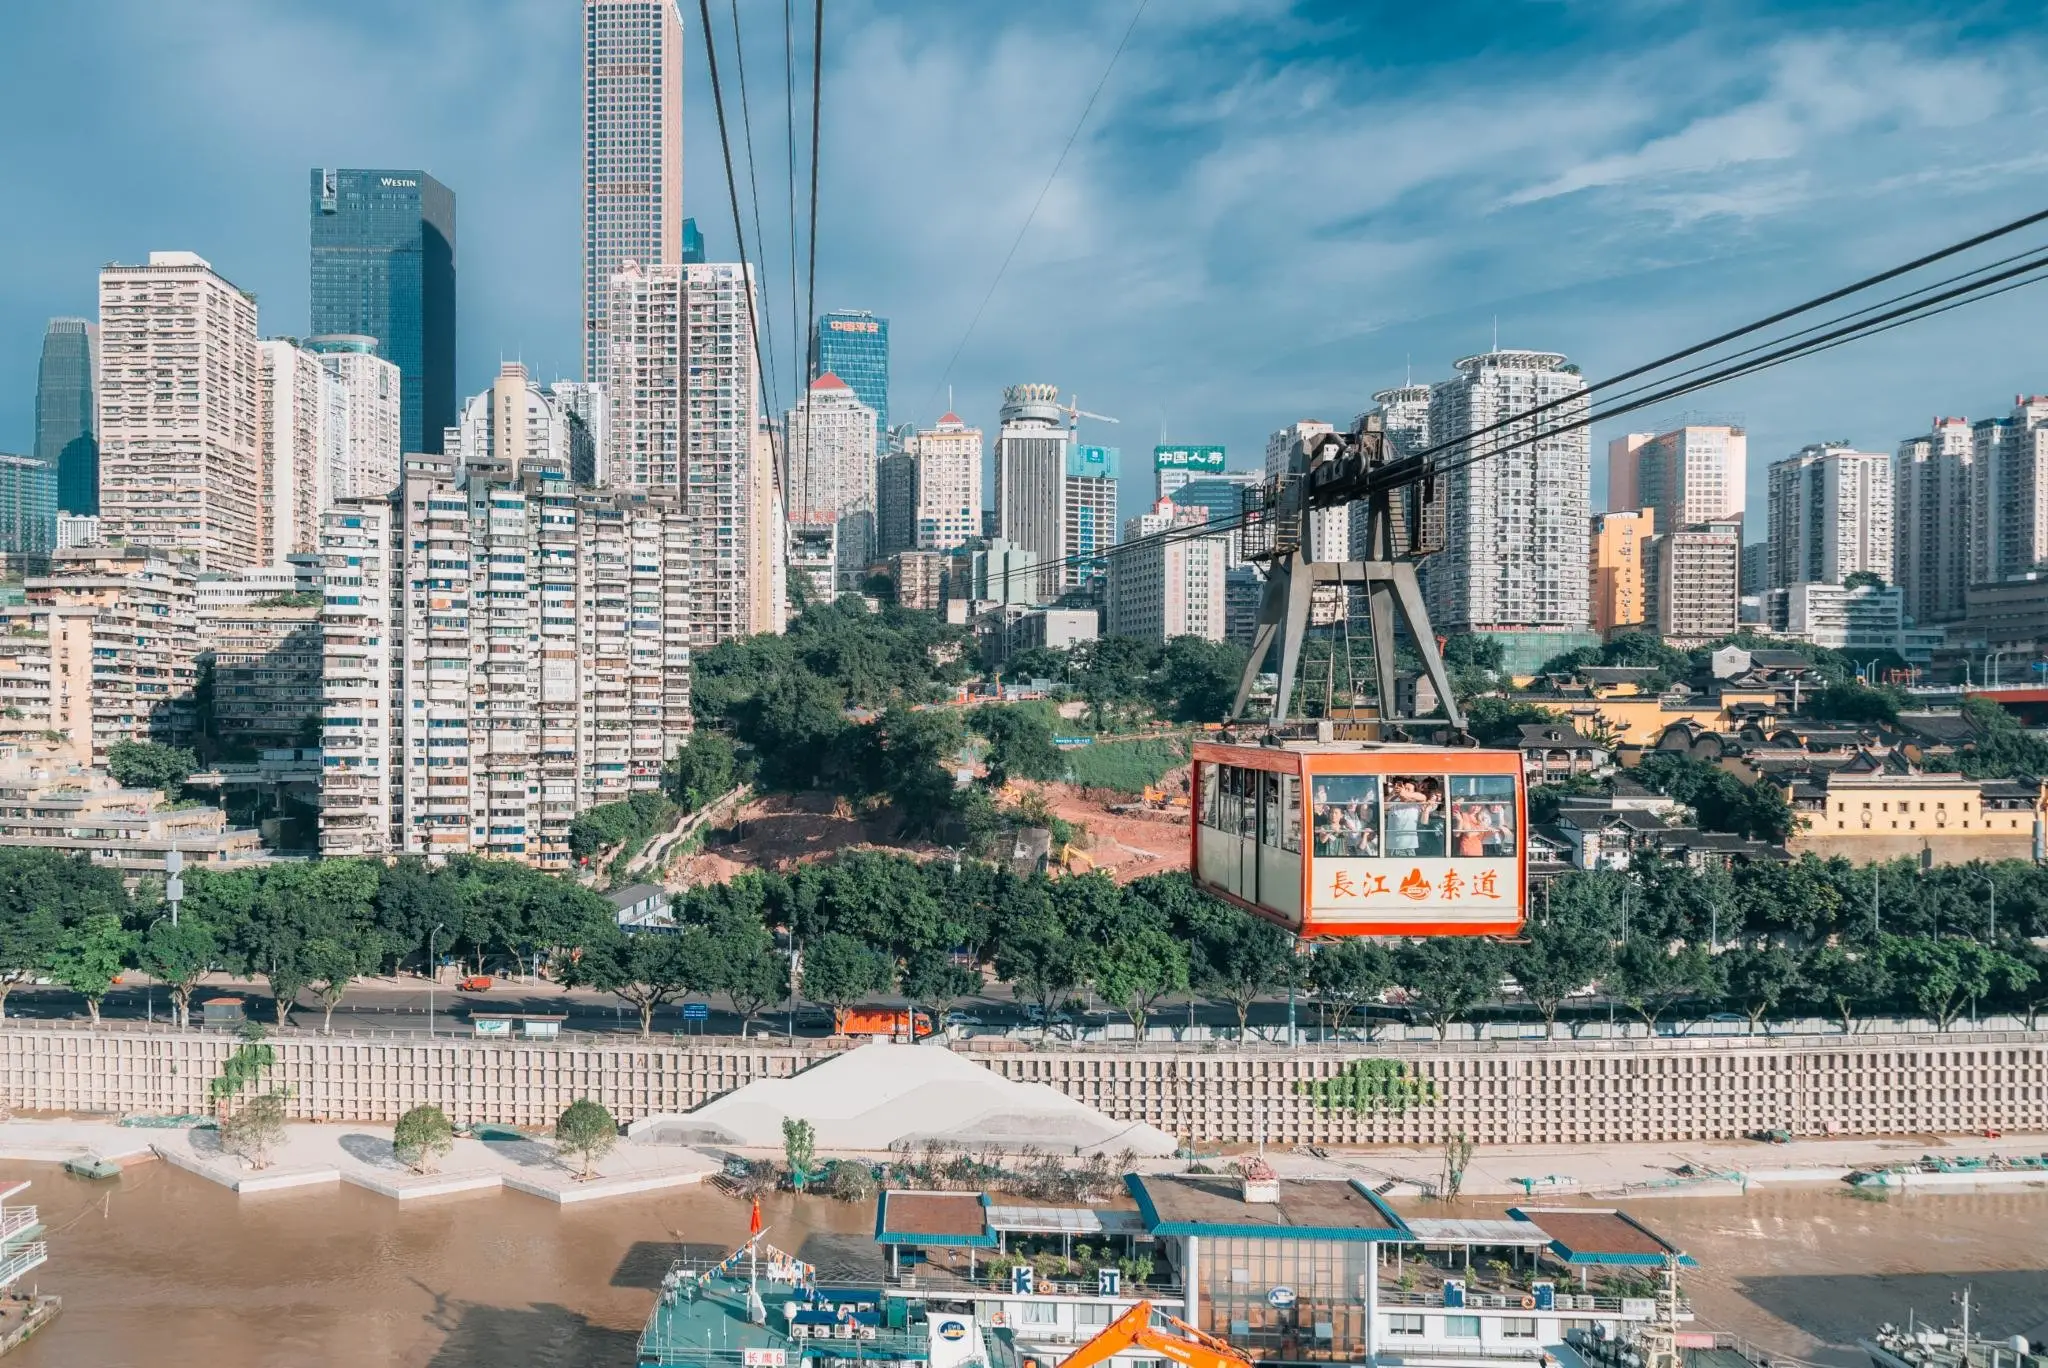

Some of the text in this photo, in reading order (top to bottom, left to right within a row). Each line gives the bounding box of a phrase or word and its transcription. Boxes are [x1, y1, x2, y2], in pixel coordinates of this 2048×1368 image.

[381, 177, 416, 187] WESTIN
[1159, 451, 1223, 464] 中国人寿
[1329, 868, 1502, 900] 長江 索道
